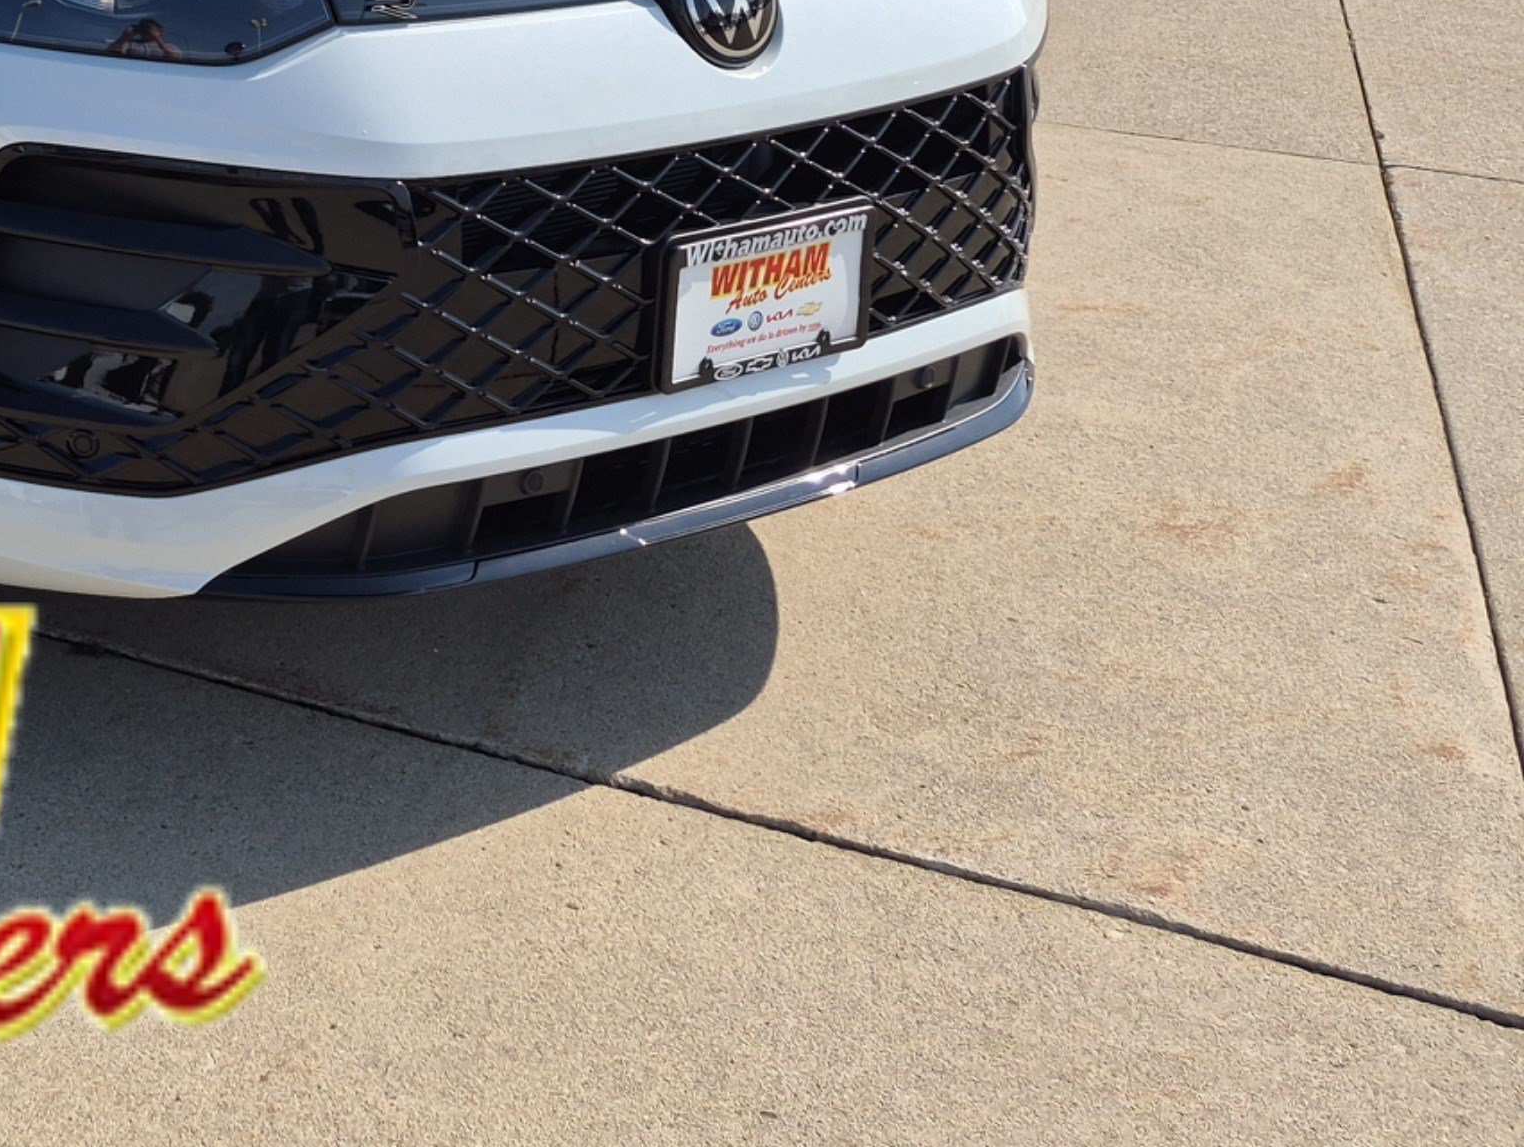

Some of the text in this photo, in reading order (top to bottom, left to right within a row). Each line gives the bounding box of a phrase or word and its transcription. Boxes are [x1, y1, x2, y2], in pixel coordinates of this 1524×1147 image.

[685, 213, 868, 268] Withamauto.com
[709, 240, 832, 299] WITHAM
[725, 267, 833, 314] Auto Centers
